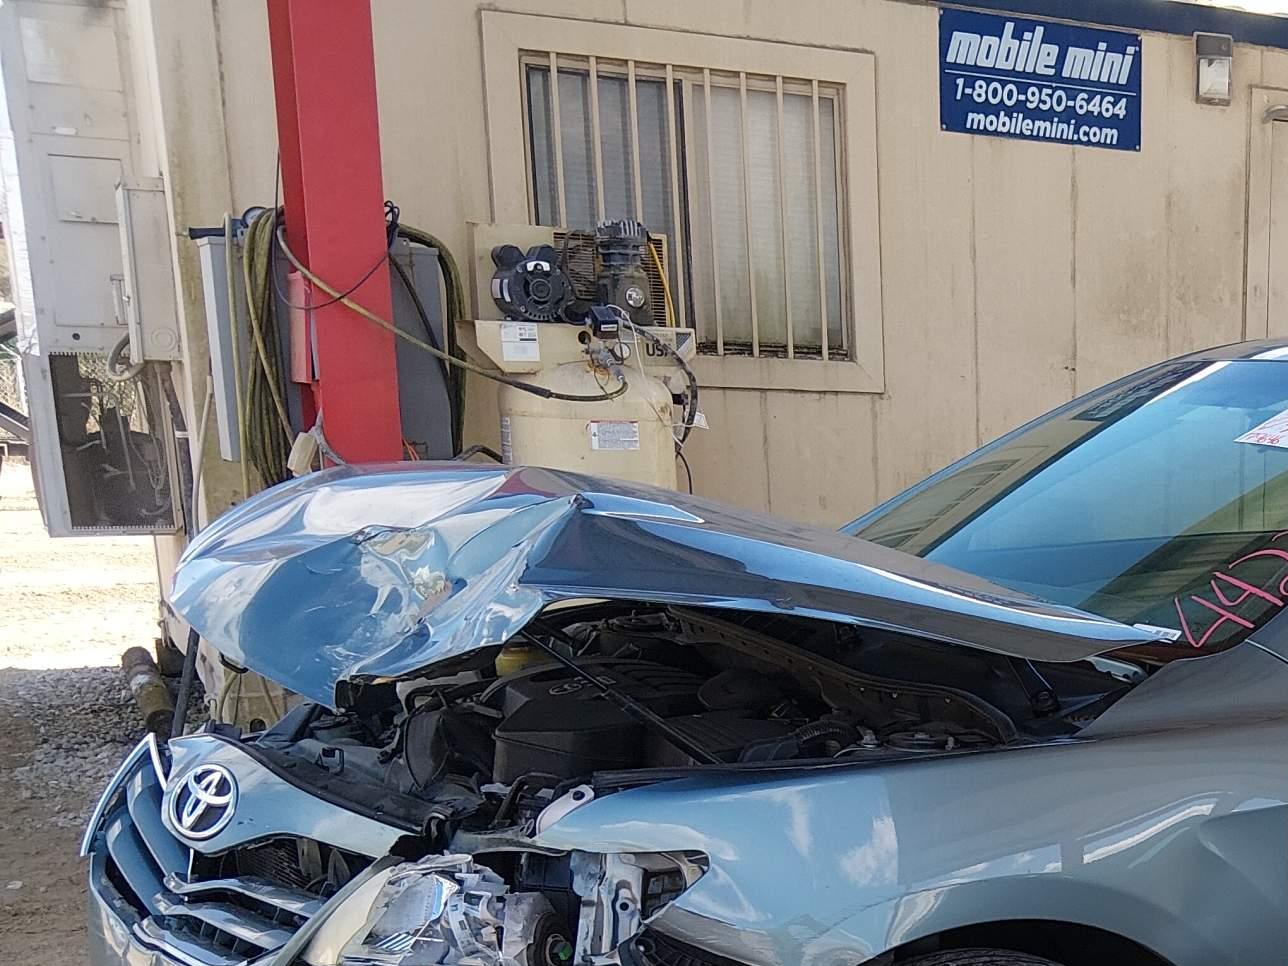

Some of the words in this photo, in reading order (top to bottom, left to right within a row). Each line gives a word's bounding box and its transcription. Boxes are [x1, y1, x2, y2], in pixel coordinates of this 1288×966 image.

[946, 22, 1059, 75] mobile
[1062, 42, 1136, 85] mini
[955, 77, 1127, 119] 1-800-950-6464
[965, 111, 1119, 145] mobilemini.com
